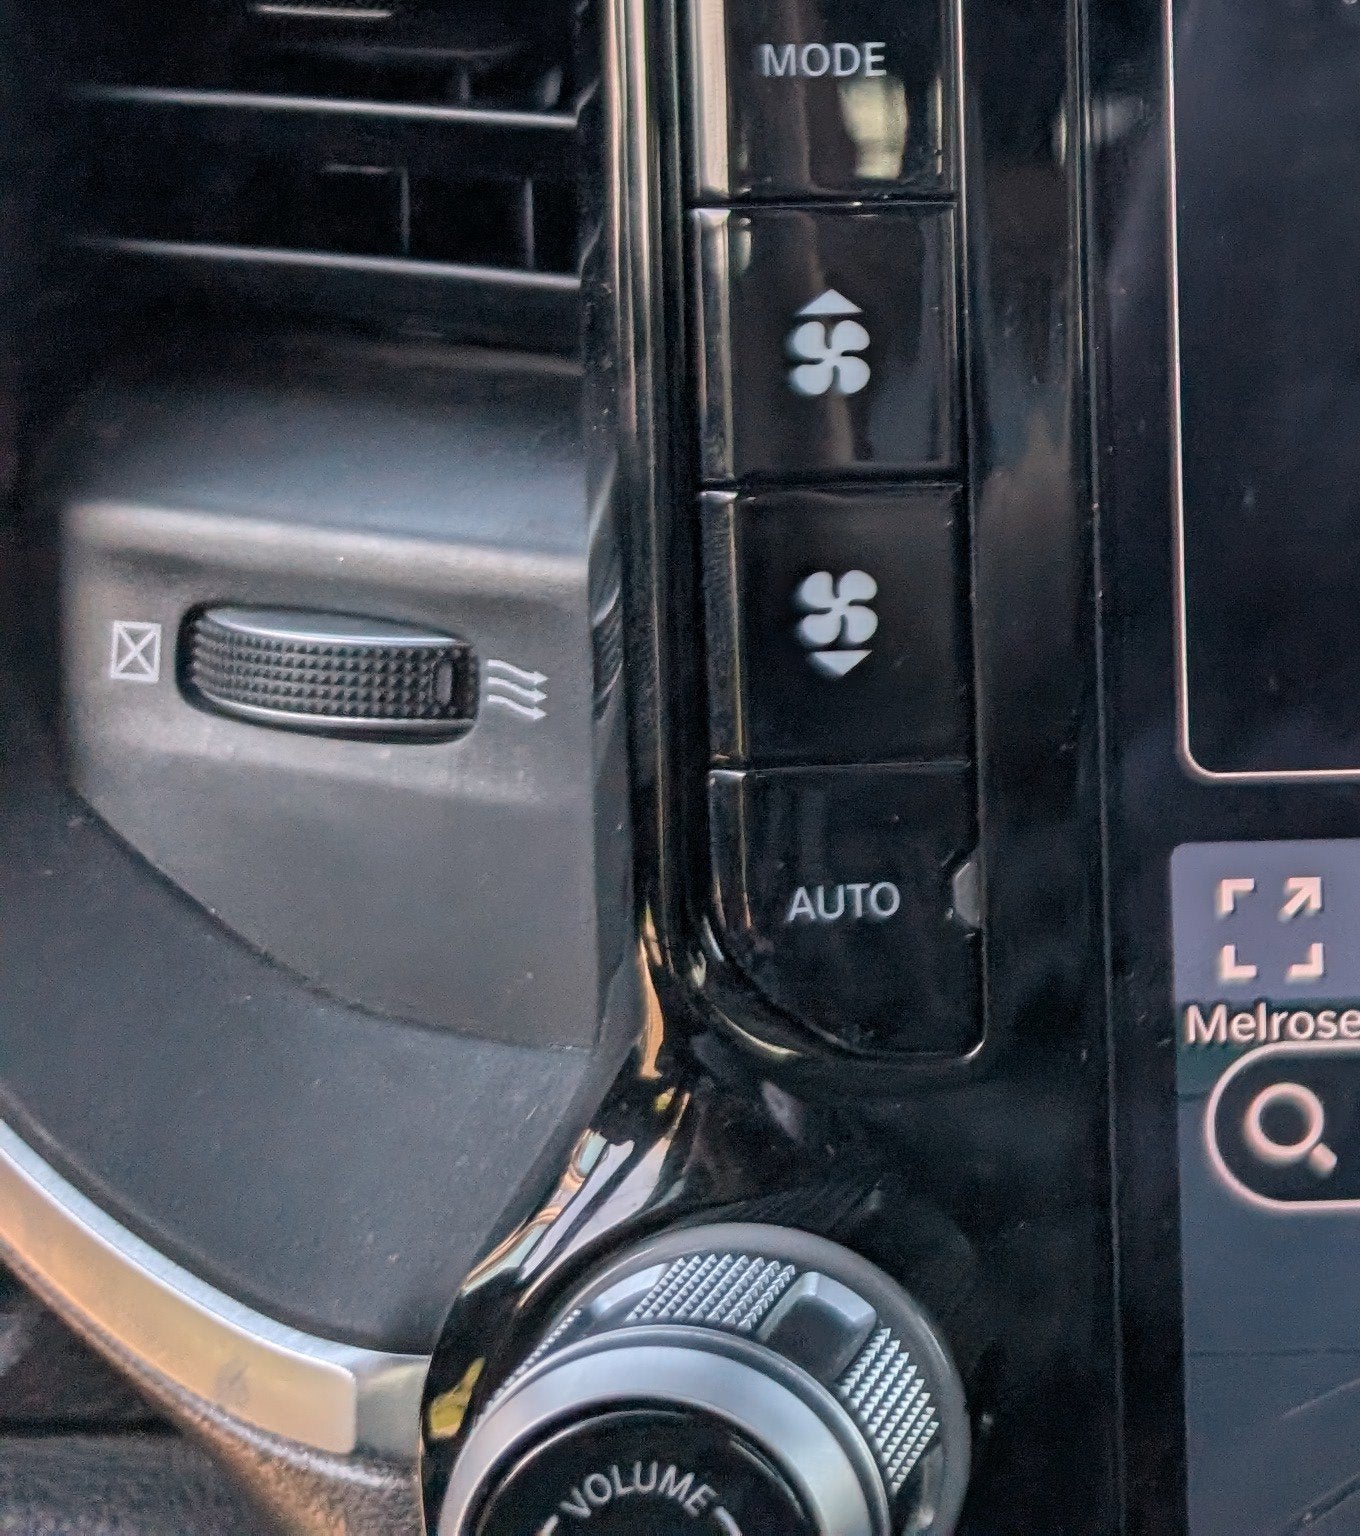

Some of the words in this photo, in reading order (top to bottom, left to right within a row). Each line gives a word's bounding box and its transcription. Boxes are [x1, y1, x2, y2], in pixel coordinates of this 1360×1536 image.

[762, 40, 887, 79] MODE
[788, 881, 902, 922] AUTO
[560, 1459, 718, 1521] VOLUME
